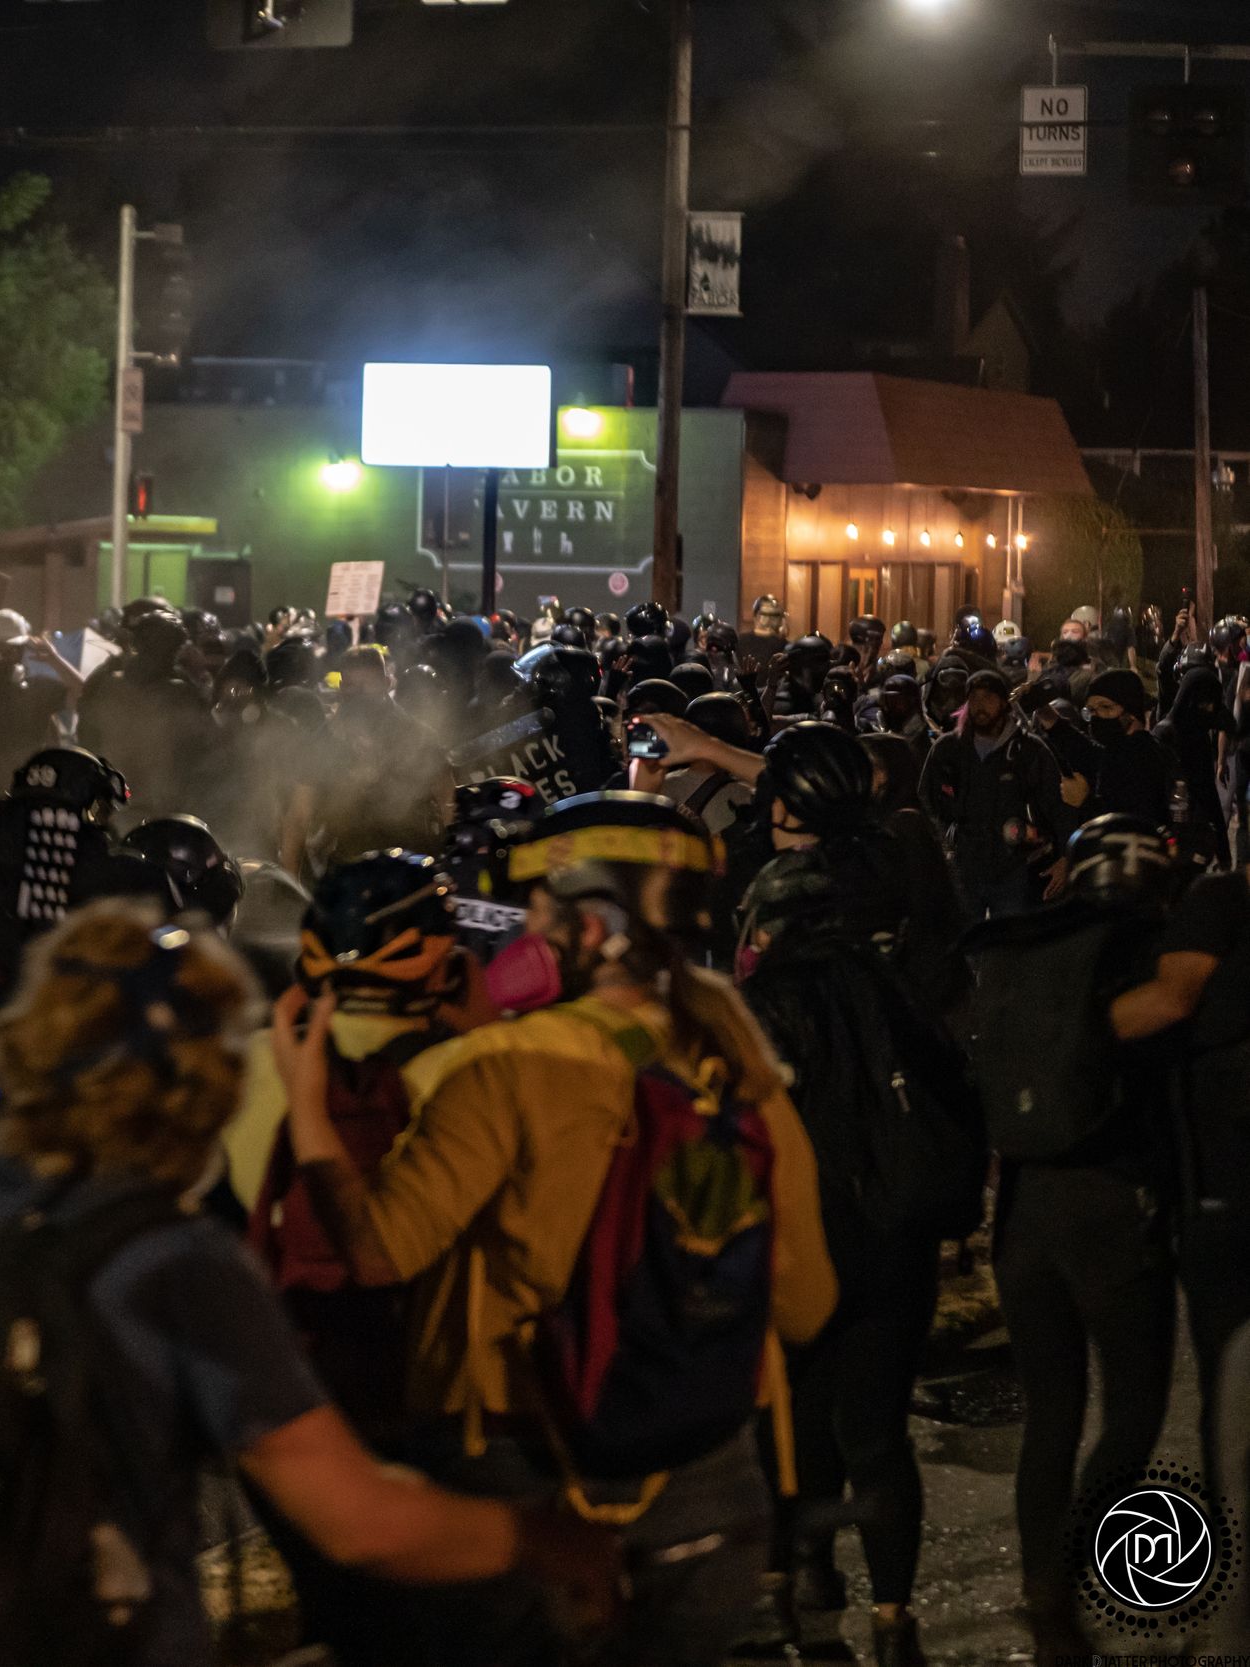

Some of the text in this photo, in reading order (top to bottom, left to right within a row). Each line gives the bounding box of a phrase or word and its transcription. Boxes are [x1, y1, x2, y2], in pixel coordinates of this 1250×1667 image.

[1040, 97, 1069, 116] NO
[1027, 124, 1081, 141] TURNS
[483, 465, 603, 487] ABOR
